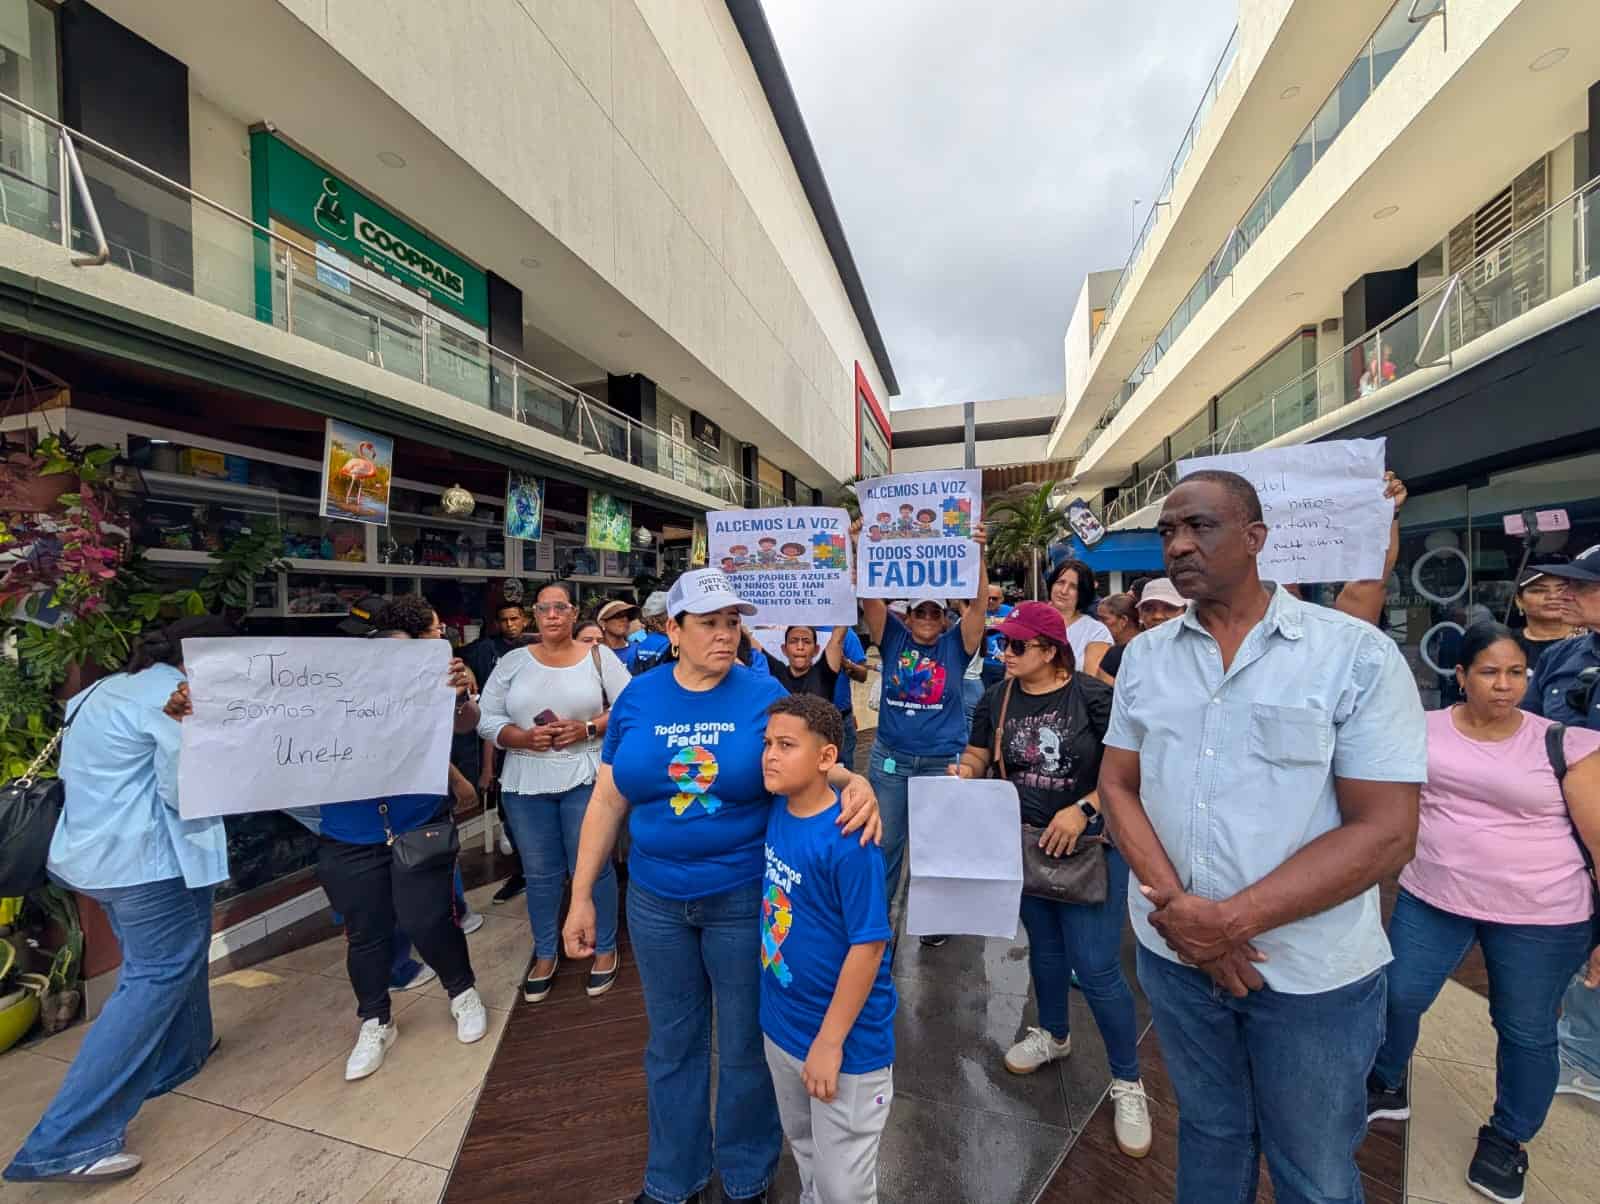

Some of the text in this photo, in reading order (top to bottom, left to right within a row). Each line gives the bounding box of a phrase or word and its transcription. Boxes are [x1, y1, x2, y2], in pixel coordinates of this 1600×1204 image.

[359, 221, 462, 294] COOPPAIS
[867, 480, 967, 499] ALCEMOS LA VOZ
[1256, 474, 1288, 493] dul
[715, 517, 840, 533] ALCEMOS LA VOZ
[867, 544, 967, 560] TODOS SOMOS
[726, 573, 756, 582] OMOS
[758, 573, 799, 582] PADRES
[800, 572, 840, 581] AZULES
[868, 560, 967, 587] FADUL
[778, 581, 800, 590] QUE
[802, 581, 825, 589] HAN
[737, 590, 817, 598] JORADO CON EL
[654, 722, 736, 736] Todos somos
[667, 732, 719, 748] Fadul
